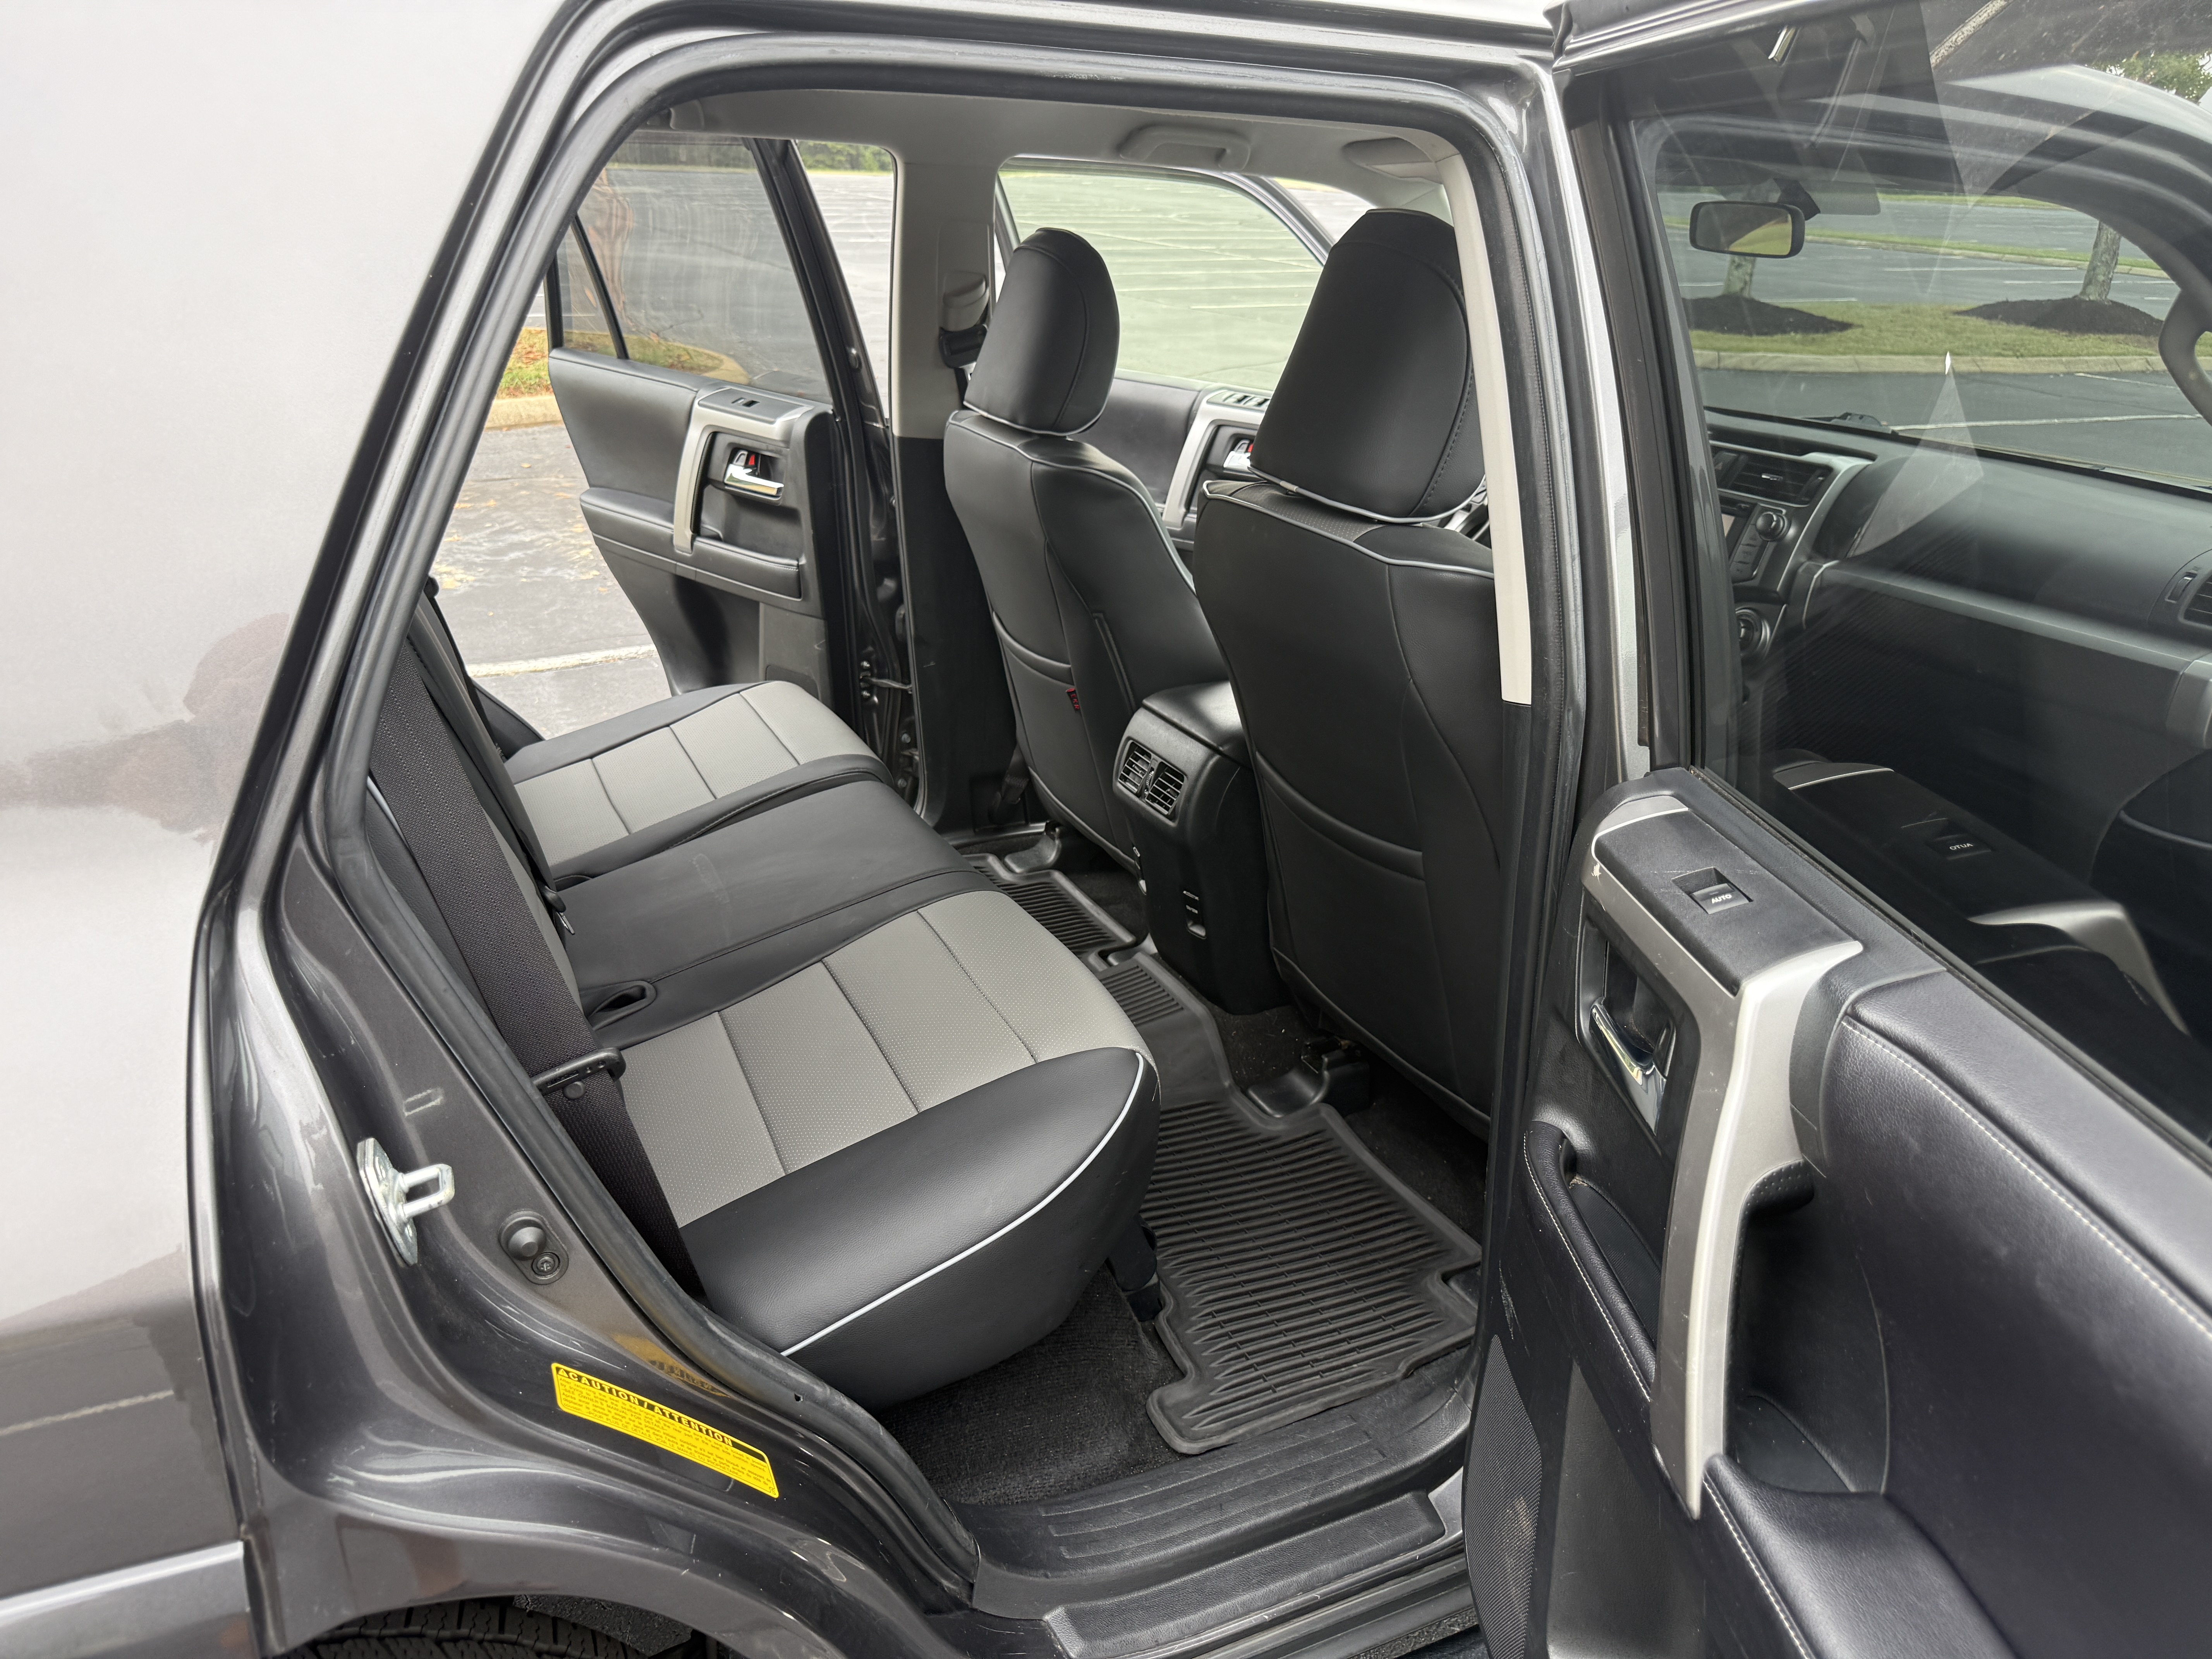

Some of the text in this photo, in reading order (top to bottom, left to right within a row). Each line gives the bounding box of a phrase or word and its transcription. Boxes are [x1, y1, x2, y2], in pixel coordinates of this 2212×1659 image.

[1711, 894, 1732, 904] AUTO
[574, 1384, 596, 1394] returning
[569, 1372, 639, 1405] CAUTION
[654, 1407, 733, 1446] ATTENTION
